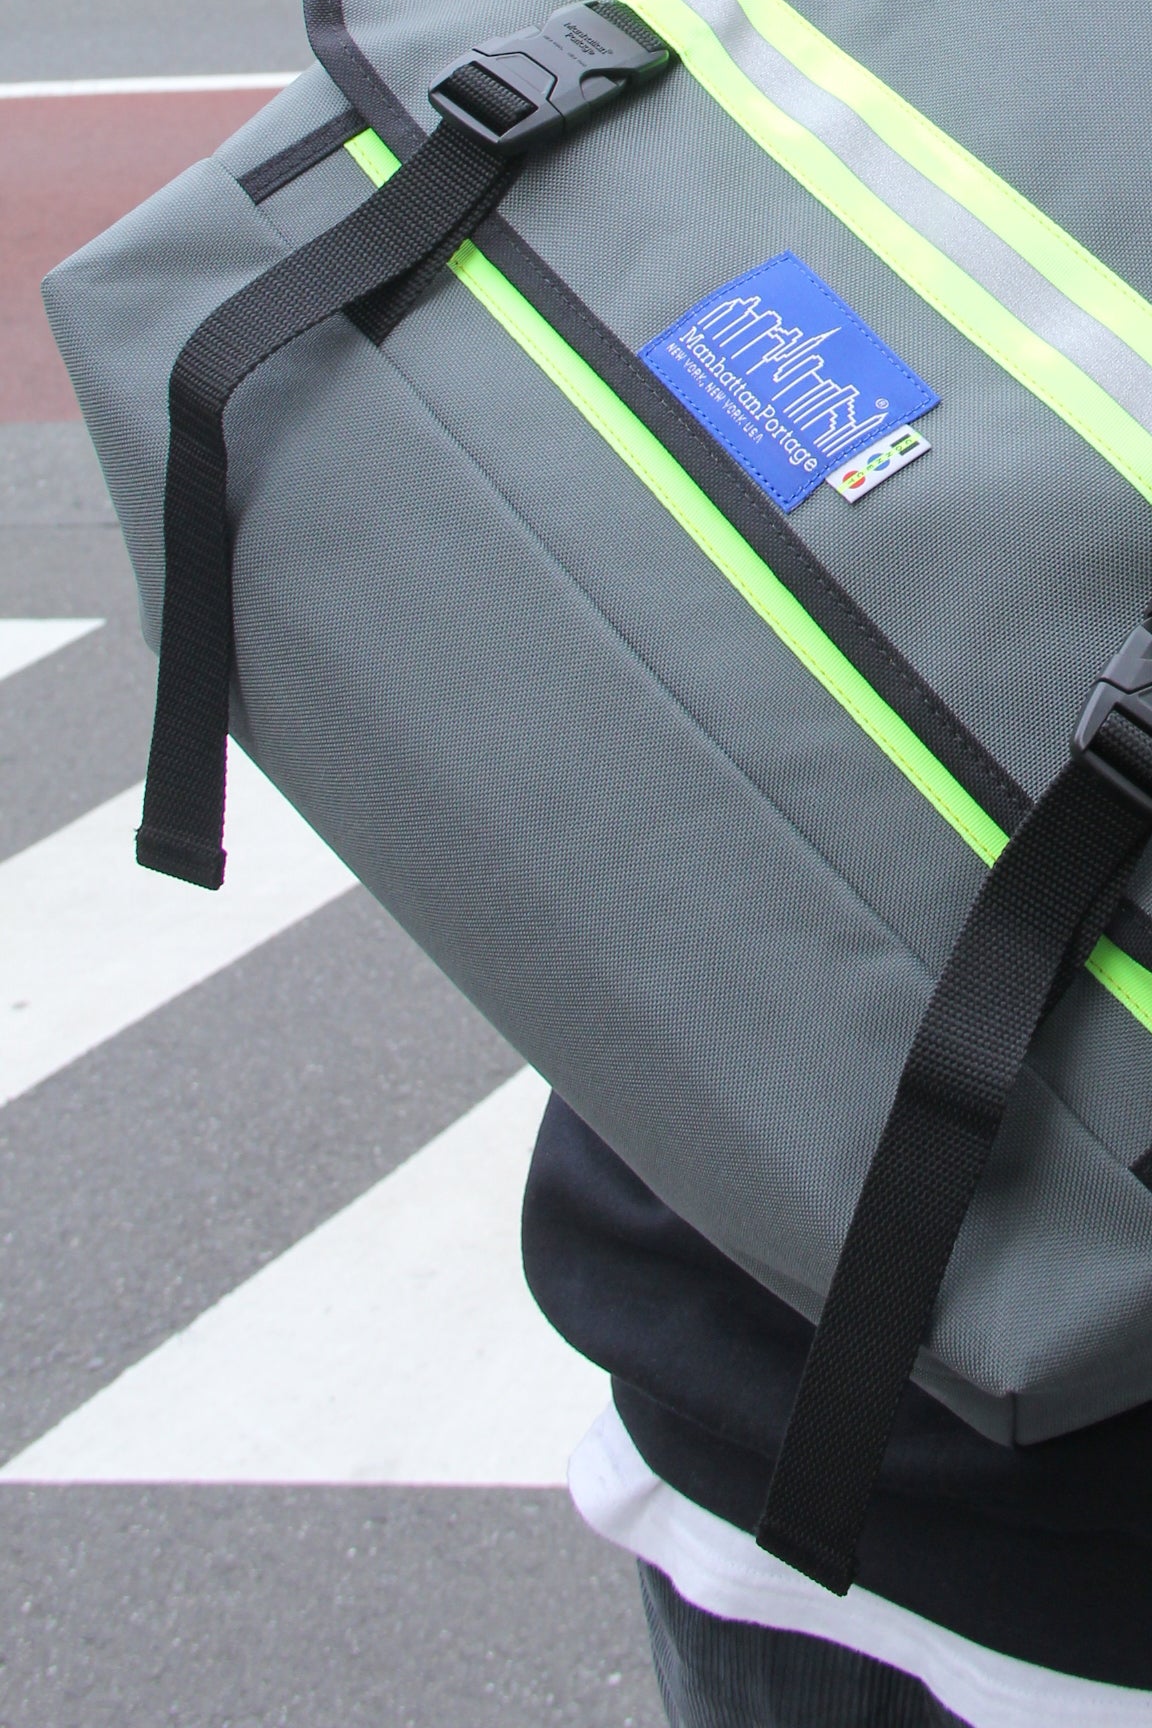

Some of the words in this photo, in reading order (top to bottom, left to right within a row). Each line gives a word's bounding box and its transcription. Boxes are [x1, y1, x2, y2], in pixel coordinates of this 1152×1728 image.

[667, 343, 685, 361] NEW
[705, 382, 726, 403] NEW
[743, 422, 764, 444] USA
[848, 439, 912, 484] CONNECT
